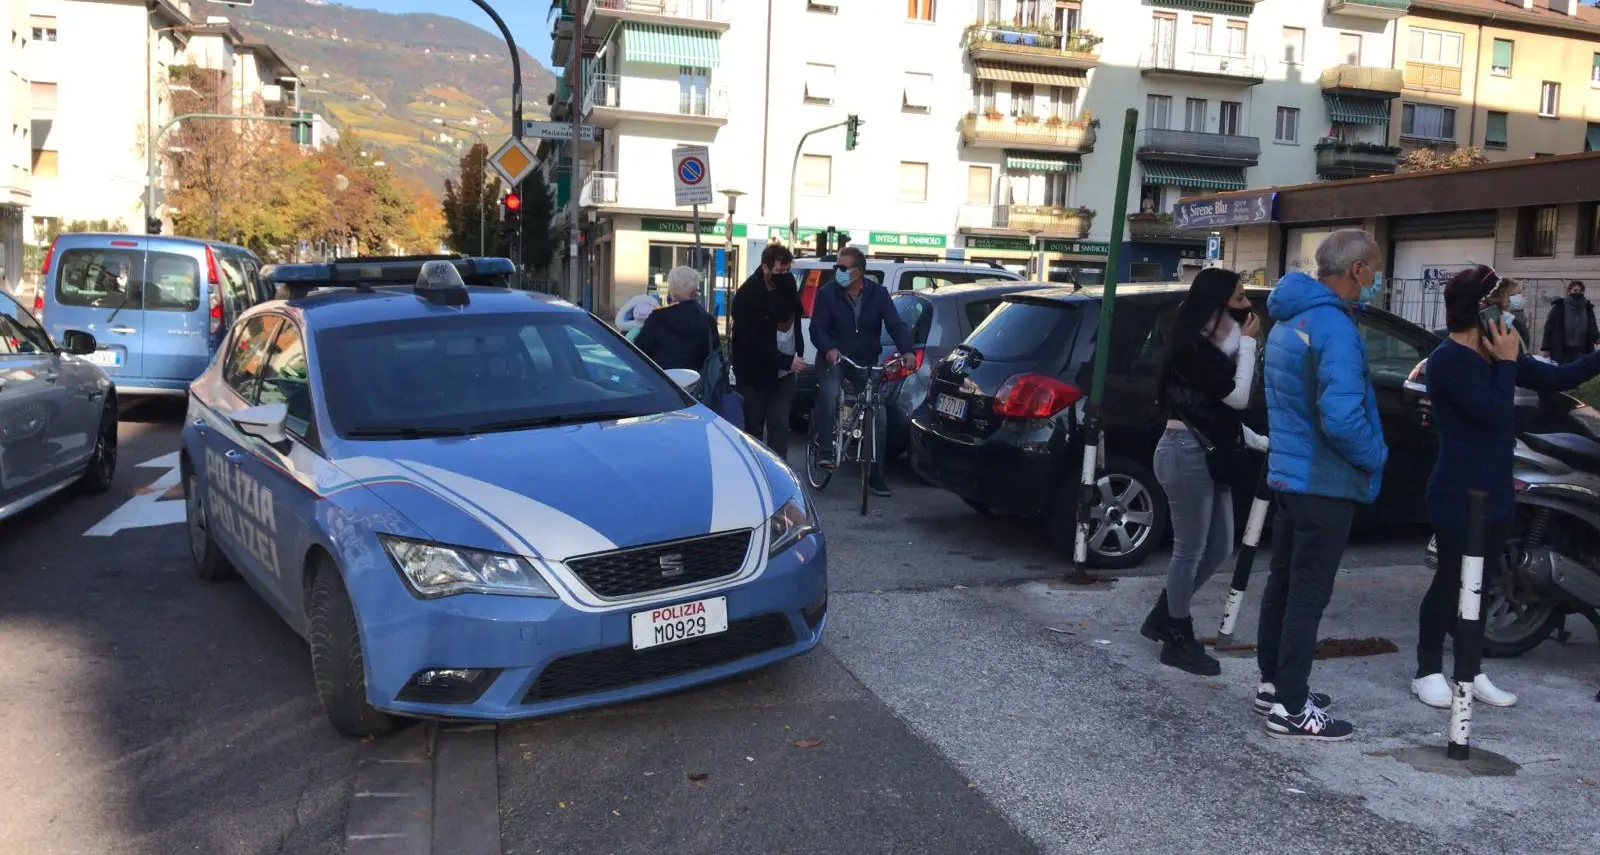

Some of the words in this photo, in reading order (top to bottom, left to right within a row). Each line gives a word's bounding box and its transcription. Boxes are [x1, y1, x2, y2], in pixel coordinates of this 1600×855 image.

[1189, 203, 1213, 217] Sirene
[1214, 199, 1228, 215] Blu
[658, 221, 684, 231] INTESA
[875, 234, 898, 244] INTESA
[1209, 238, 1217, 257] P
[205, 446, 277, 534] POLIZIA
[208, 486, 281, 581] POLIZEI
[652, 602, 706, 622] POLIZIA
[654, 617, 706, 644] M0929
